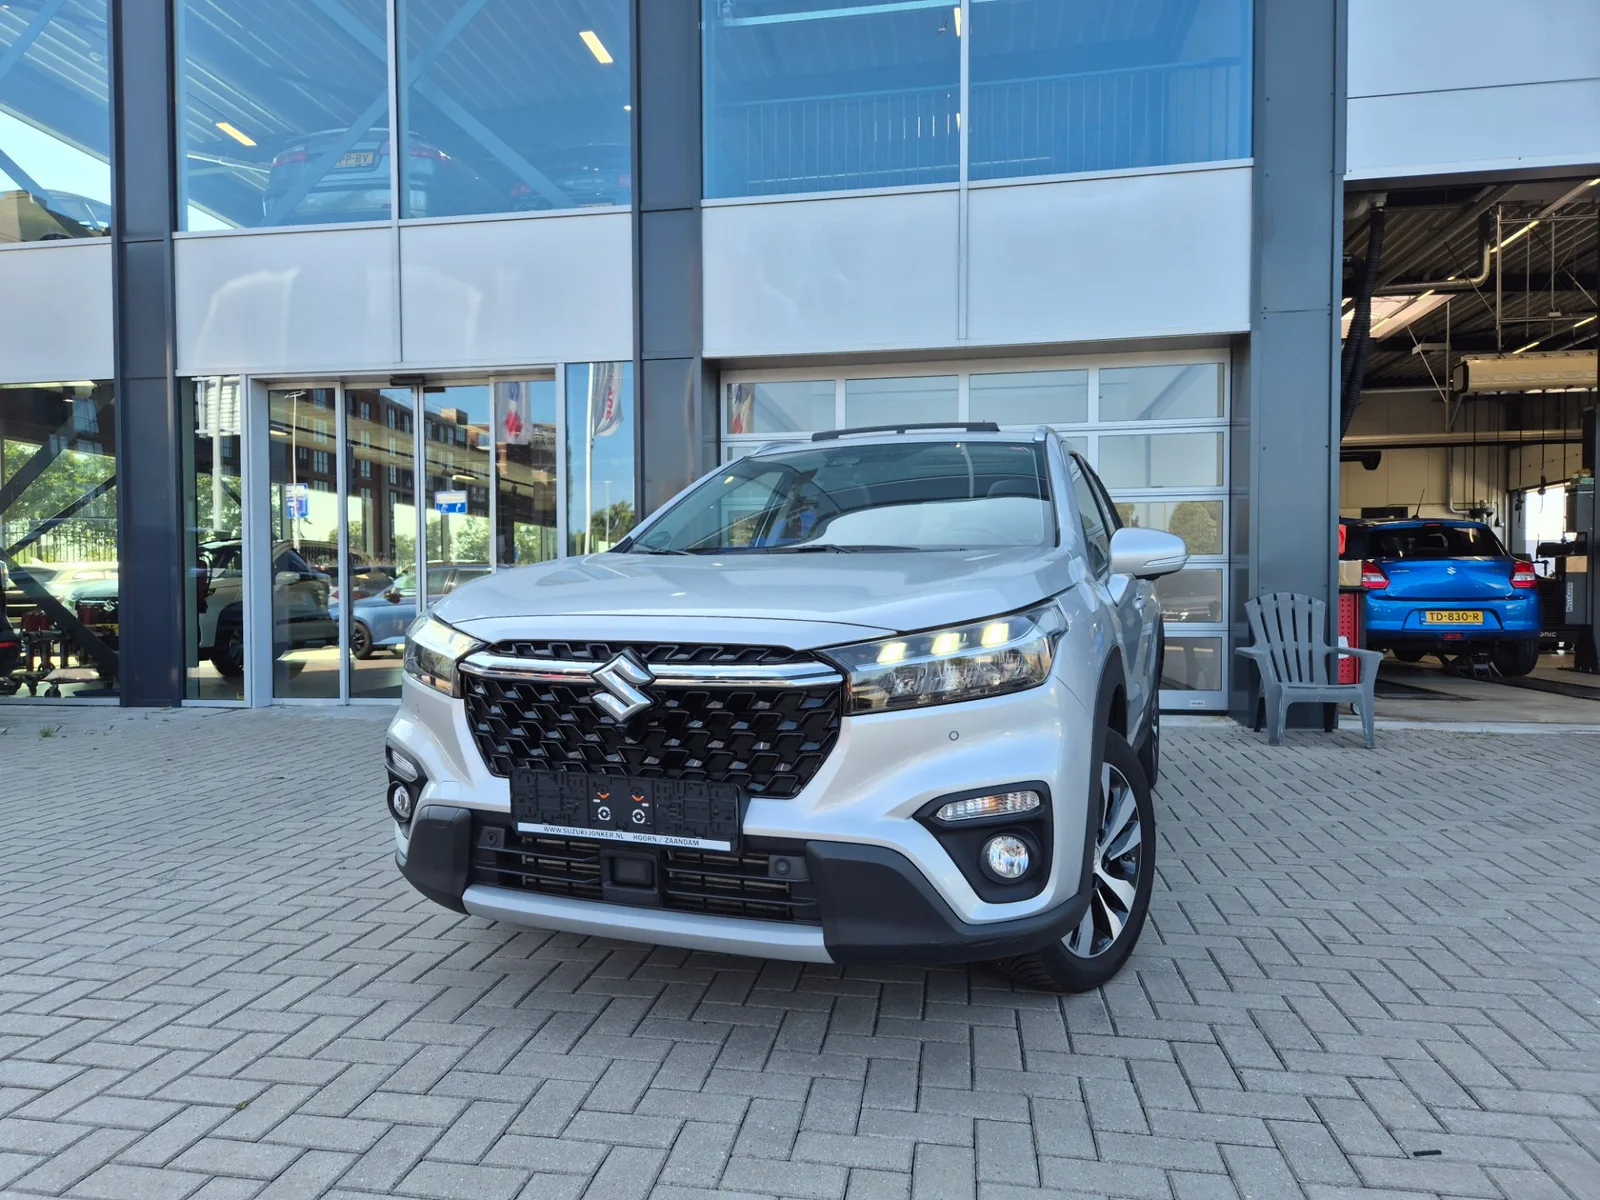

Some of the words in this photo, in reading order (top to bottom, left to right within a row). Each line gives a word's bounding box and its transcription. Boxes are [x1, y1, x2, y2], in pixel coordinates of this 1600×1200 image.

[1429, 612, 1479, 621] TD-830-R
[633, 834, 657, 842] HOORN
[665, 837, 700, 846] ZAANDAM
